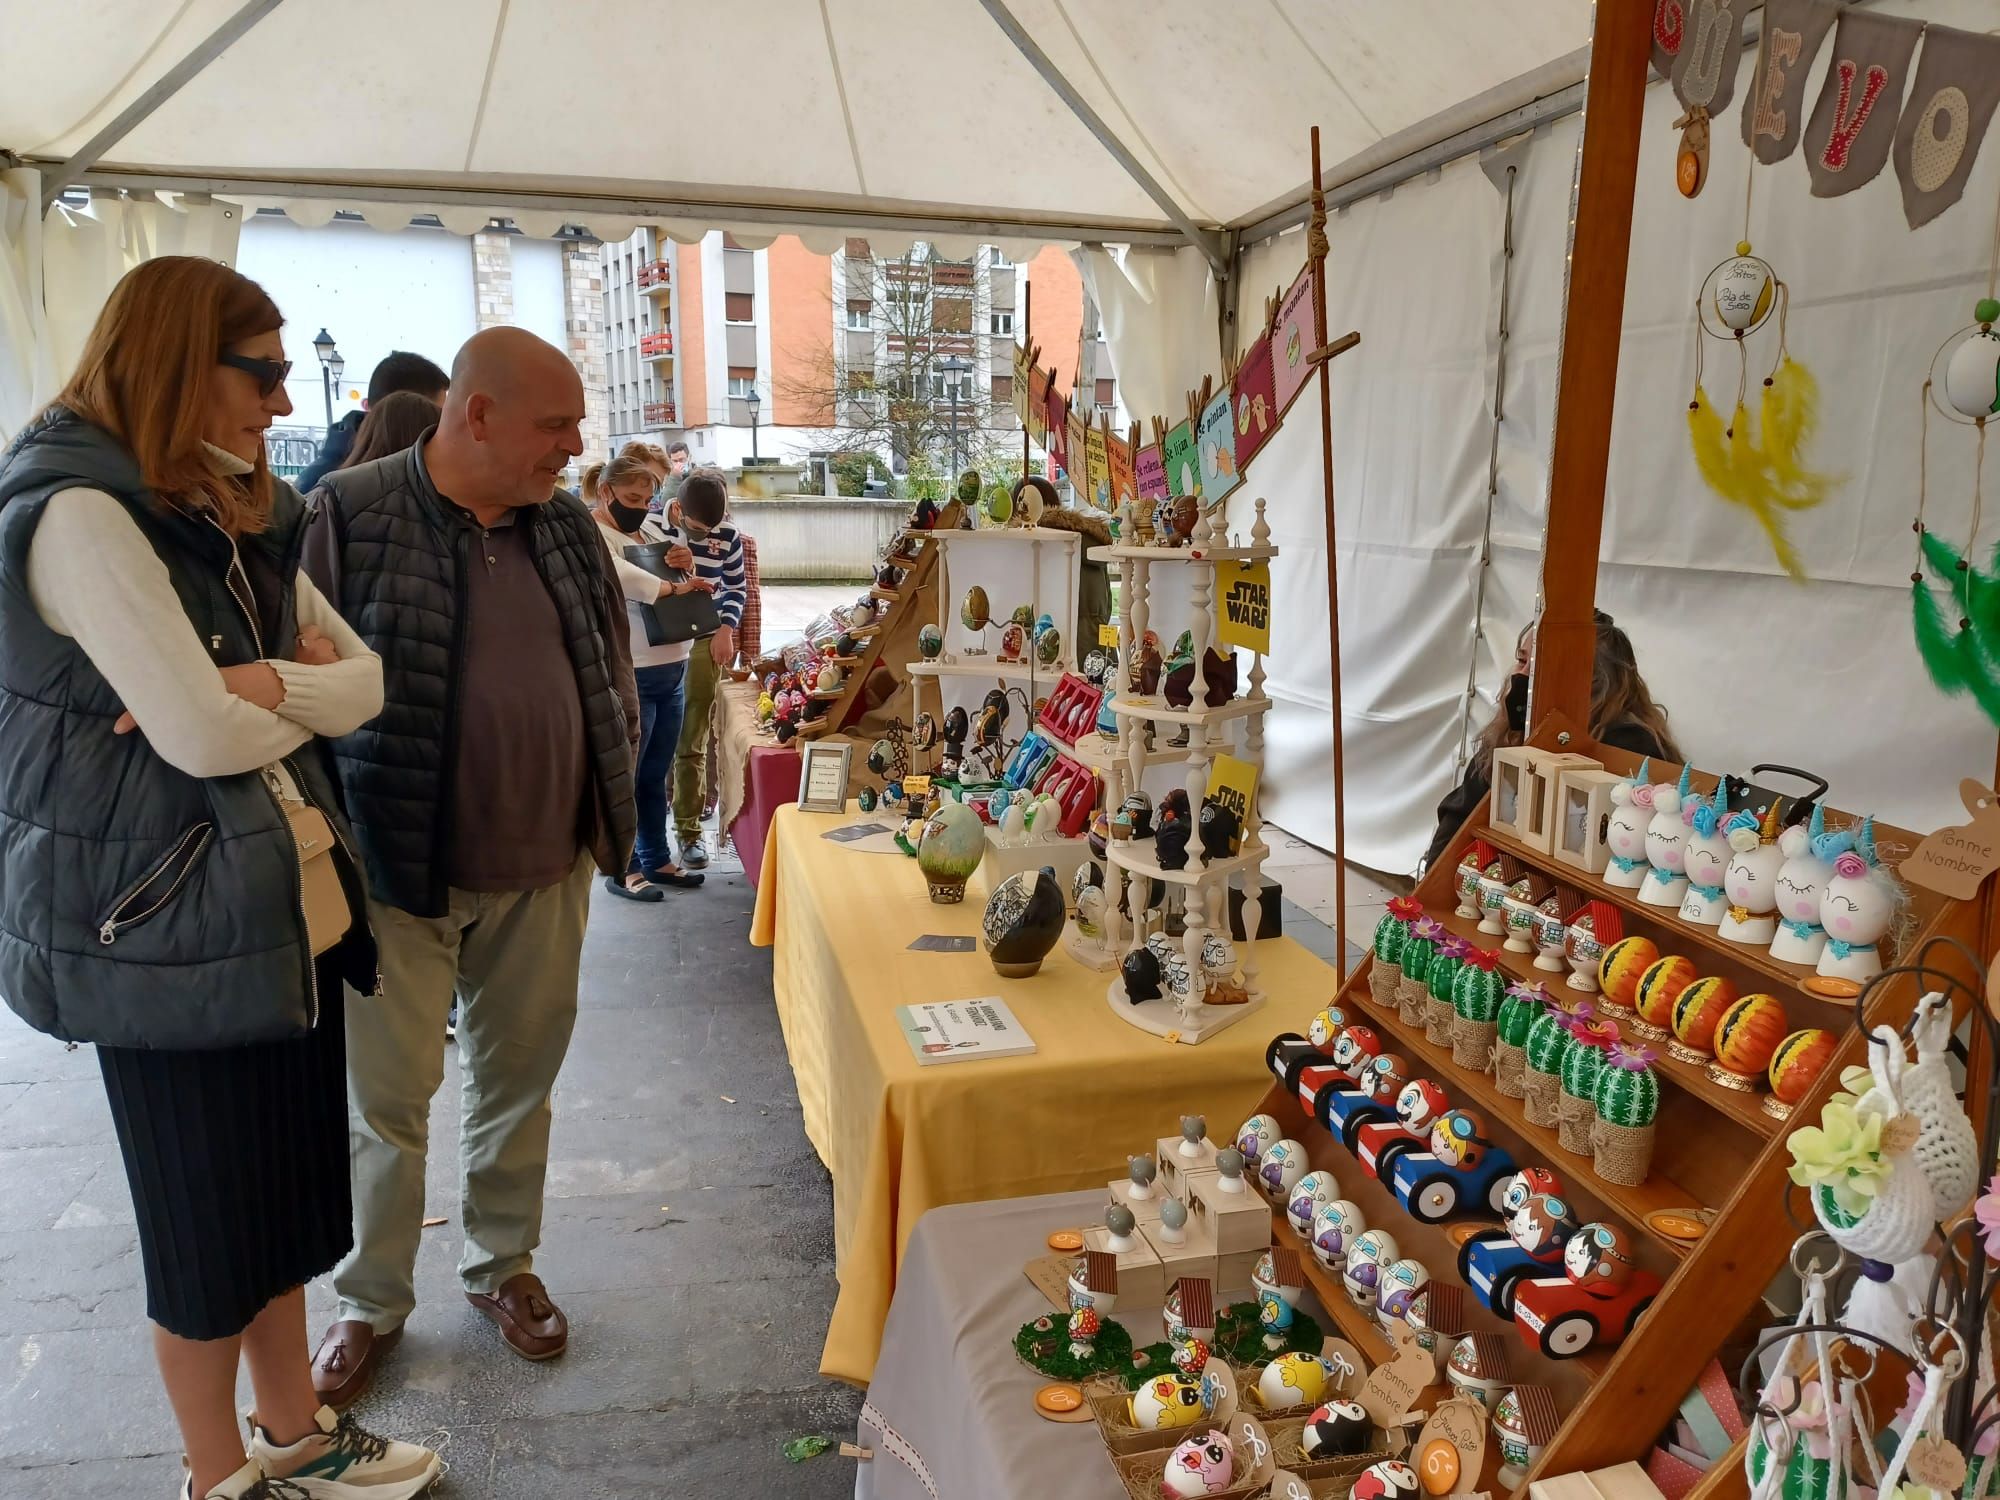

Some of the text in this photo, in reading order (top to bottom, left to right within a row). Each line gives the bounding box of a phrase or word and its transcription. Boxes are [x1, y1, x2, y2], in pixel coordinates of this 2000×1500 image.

[1283, 277, 1310, 322] montan
[1739, 290, 1752, 301] de
[1206, 400, 1228, 431] pintan
[1165, 437, 1189, 462] Se lijan
[1226, 580, 1268, 607] STAR
[1226, 601, 1268, 630] WARS
[1210, 785, 1246, 816] STAR
[1923, 850, 1983, 876] Nombre
[1380, 1363, 1416, 1399] Ponme
[1366, 1379, 1402, 1414] nombre
[1457, 1428, 1478, 1452] Pintos
